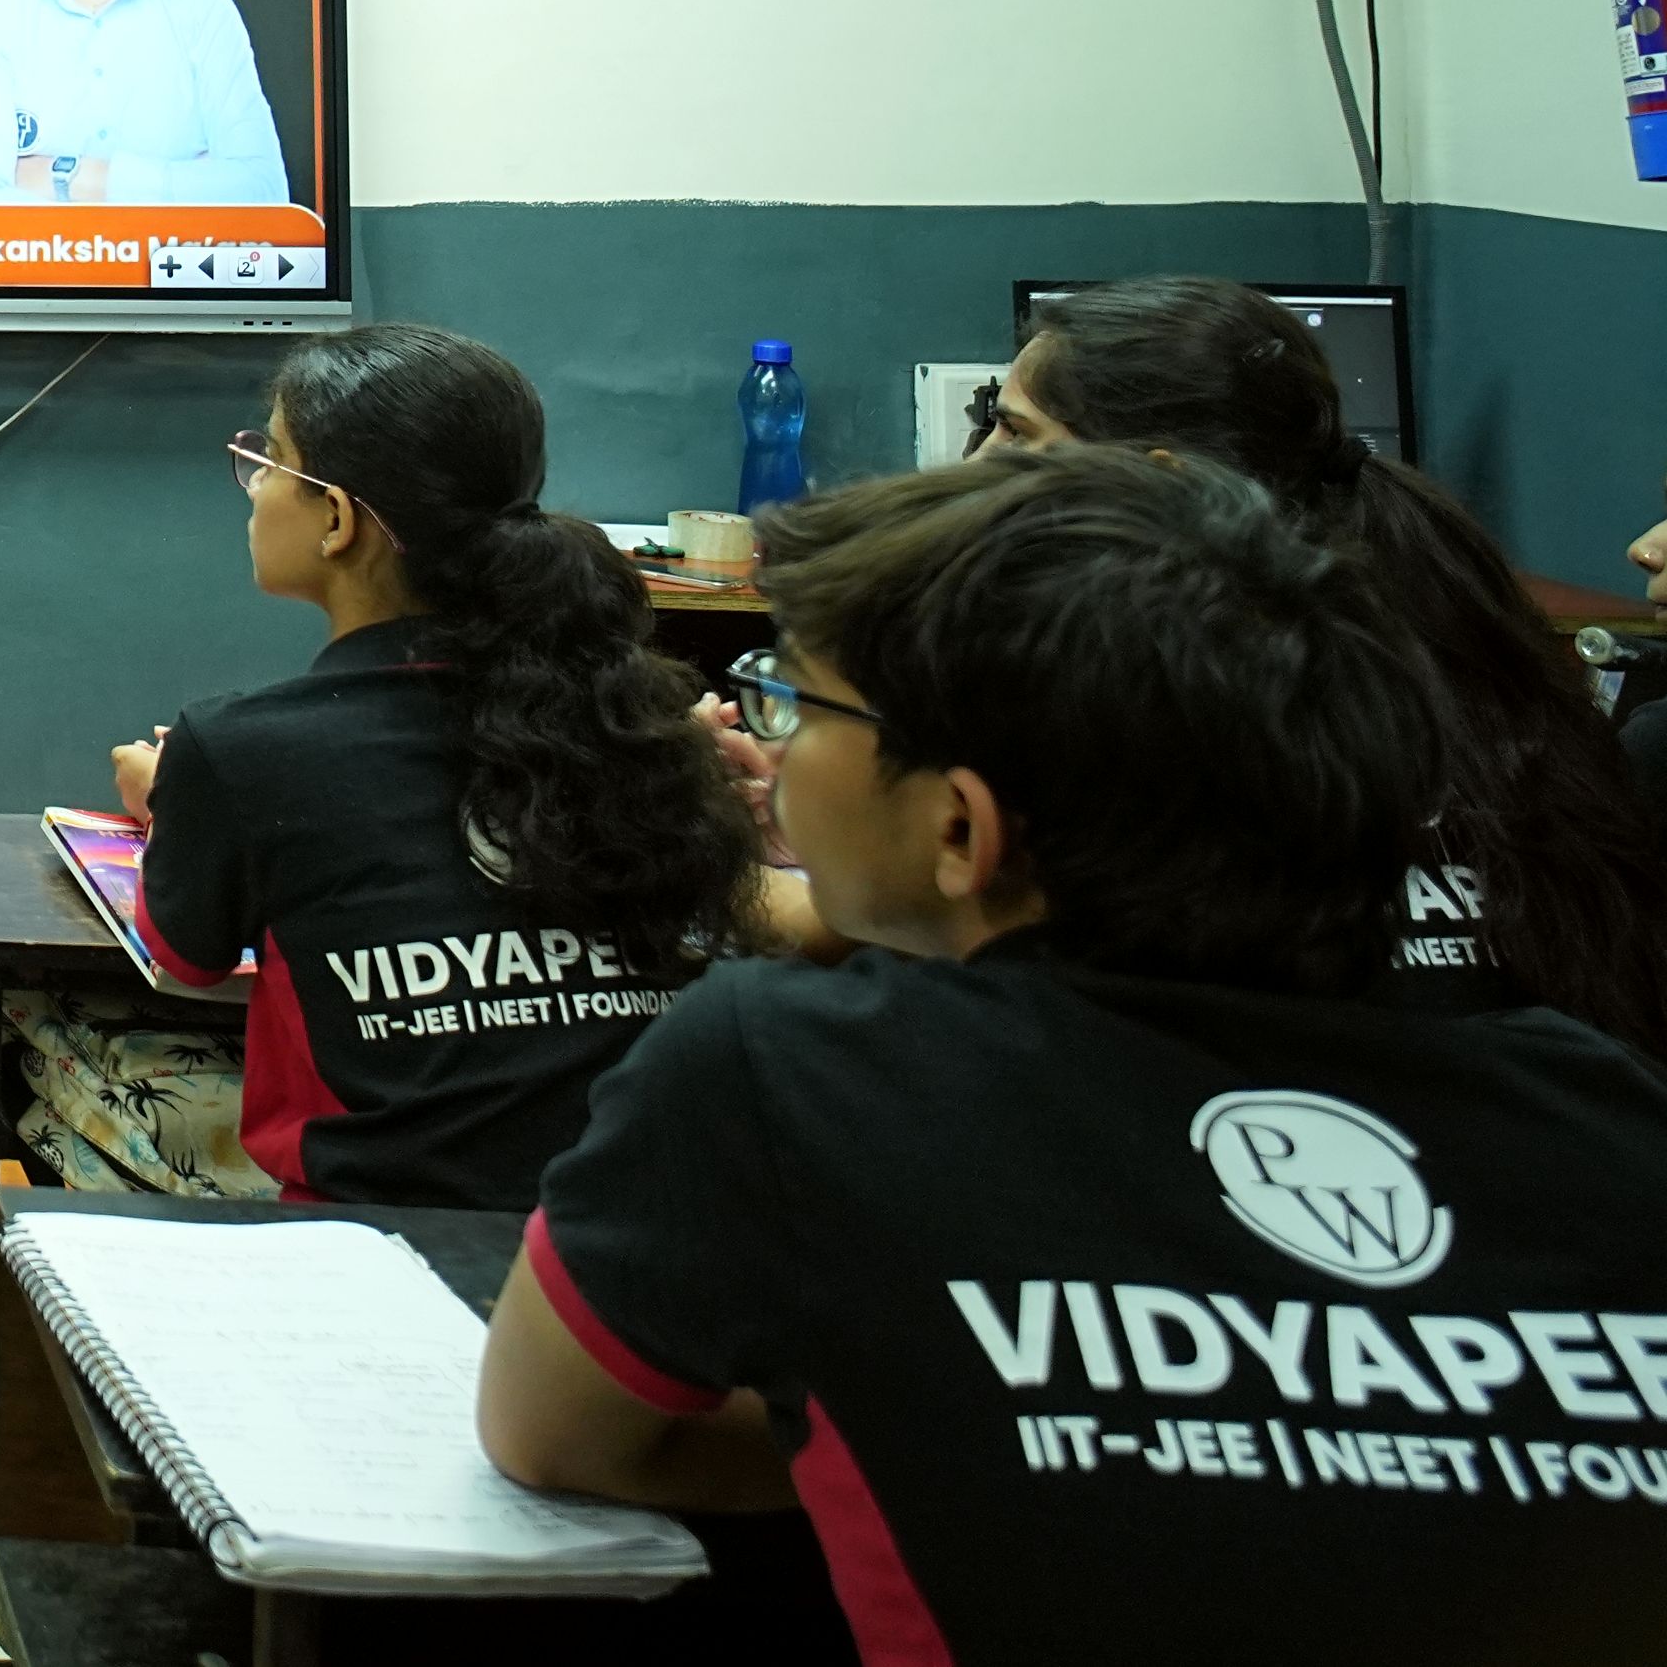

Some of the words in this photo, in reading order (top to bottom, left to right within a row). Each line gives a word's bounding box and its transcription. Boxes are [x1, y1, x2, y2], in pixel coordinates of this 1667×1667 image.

[242, 261, 250, 274] 2
[1401, 937, 1477, 966] NEET
[357, 1005, 460, 1040] IIT-JEE
[481, 997, 553, 1027] NEET
[1231, 1121, 1406, 1268] PW
[1017, 1415, 1265, 1479] IIT-JEE
[1304, 1427, 1482, 1493] NEET
